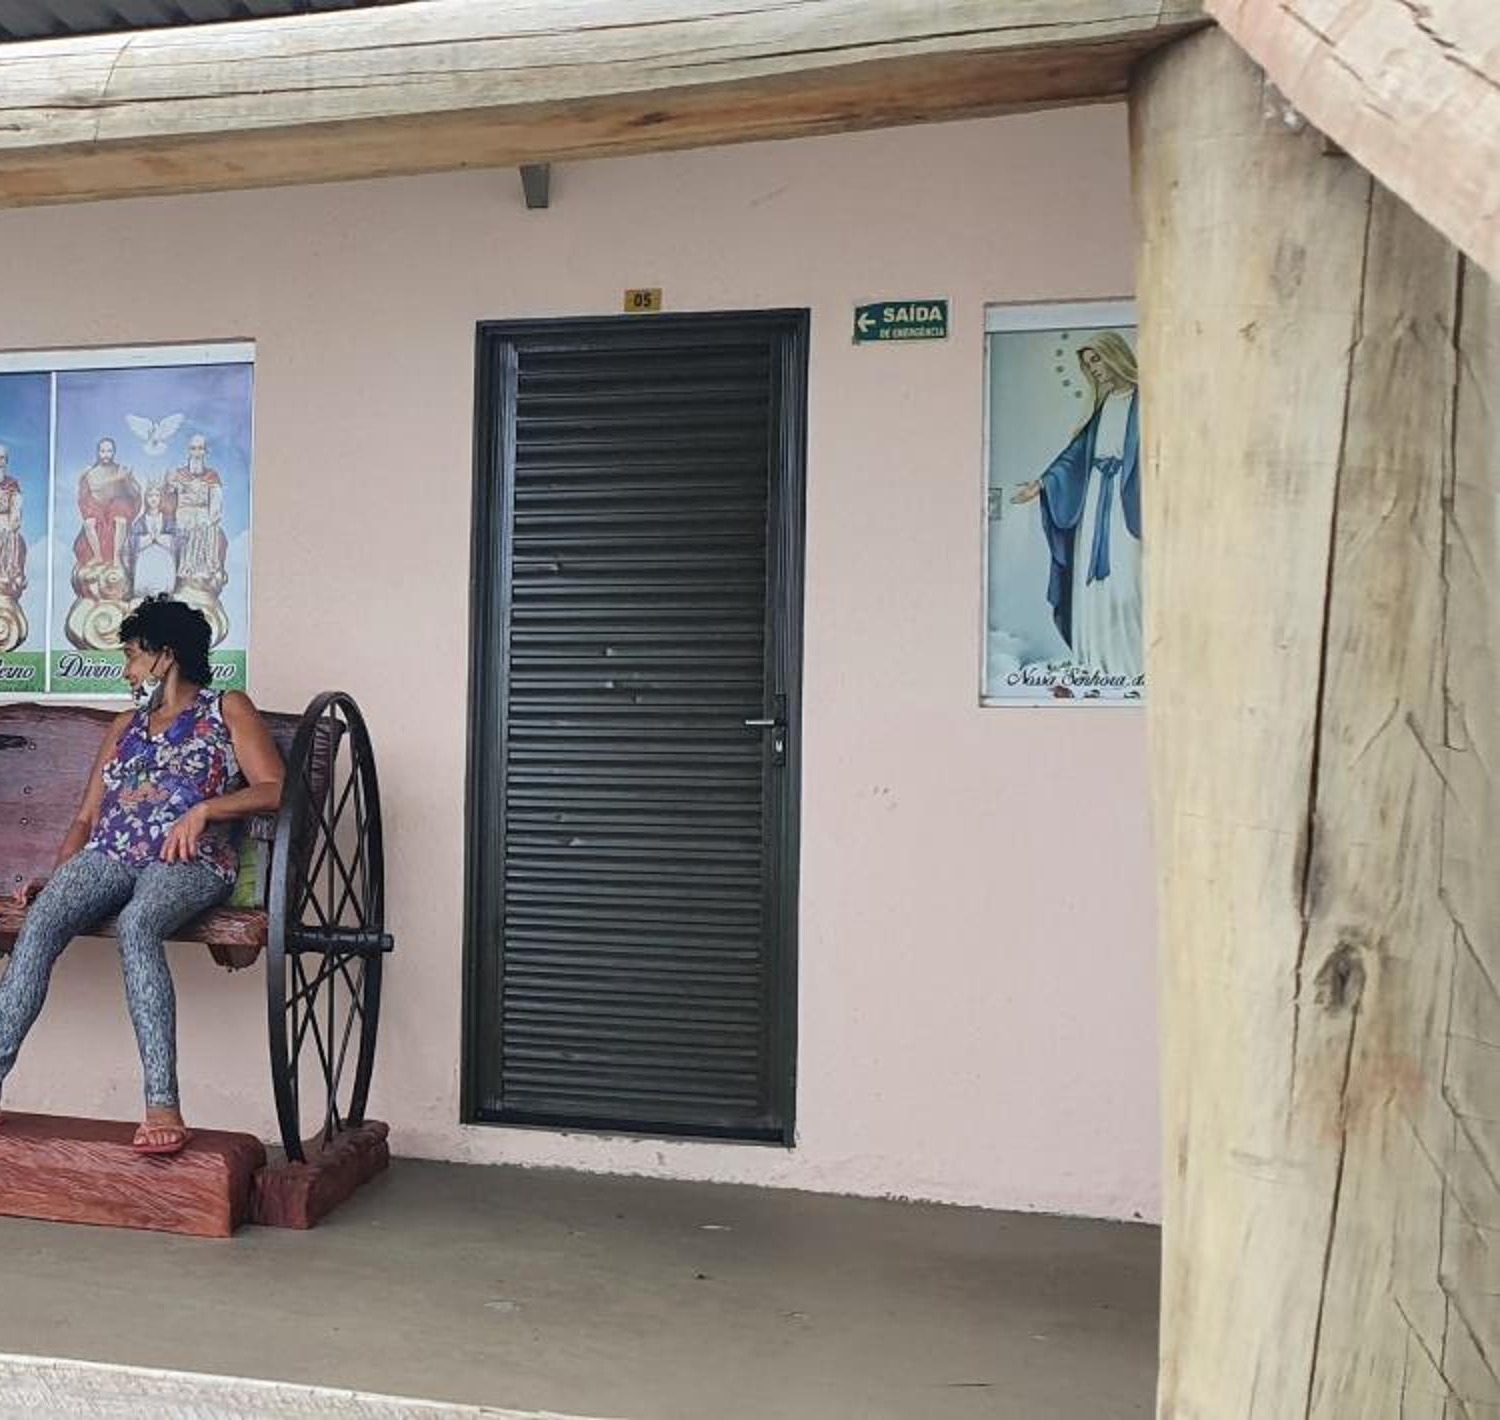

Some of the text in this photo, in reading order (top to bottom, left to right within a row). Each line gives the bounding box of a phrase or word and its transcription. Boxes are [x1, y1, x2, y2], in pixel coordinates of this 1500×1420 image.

[633, 293, 652, 307] 05
[883, 303, 943, 323] SAÍDA
[57, 653, 122, 678] Divino
[1007, 667, 1146, 687] Nossa Senhora d
